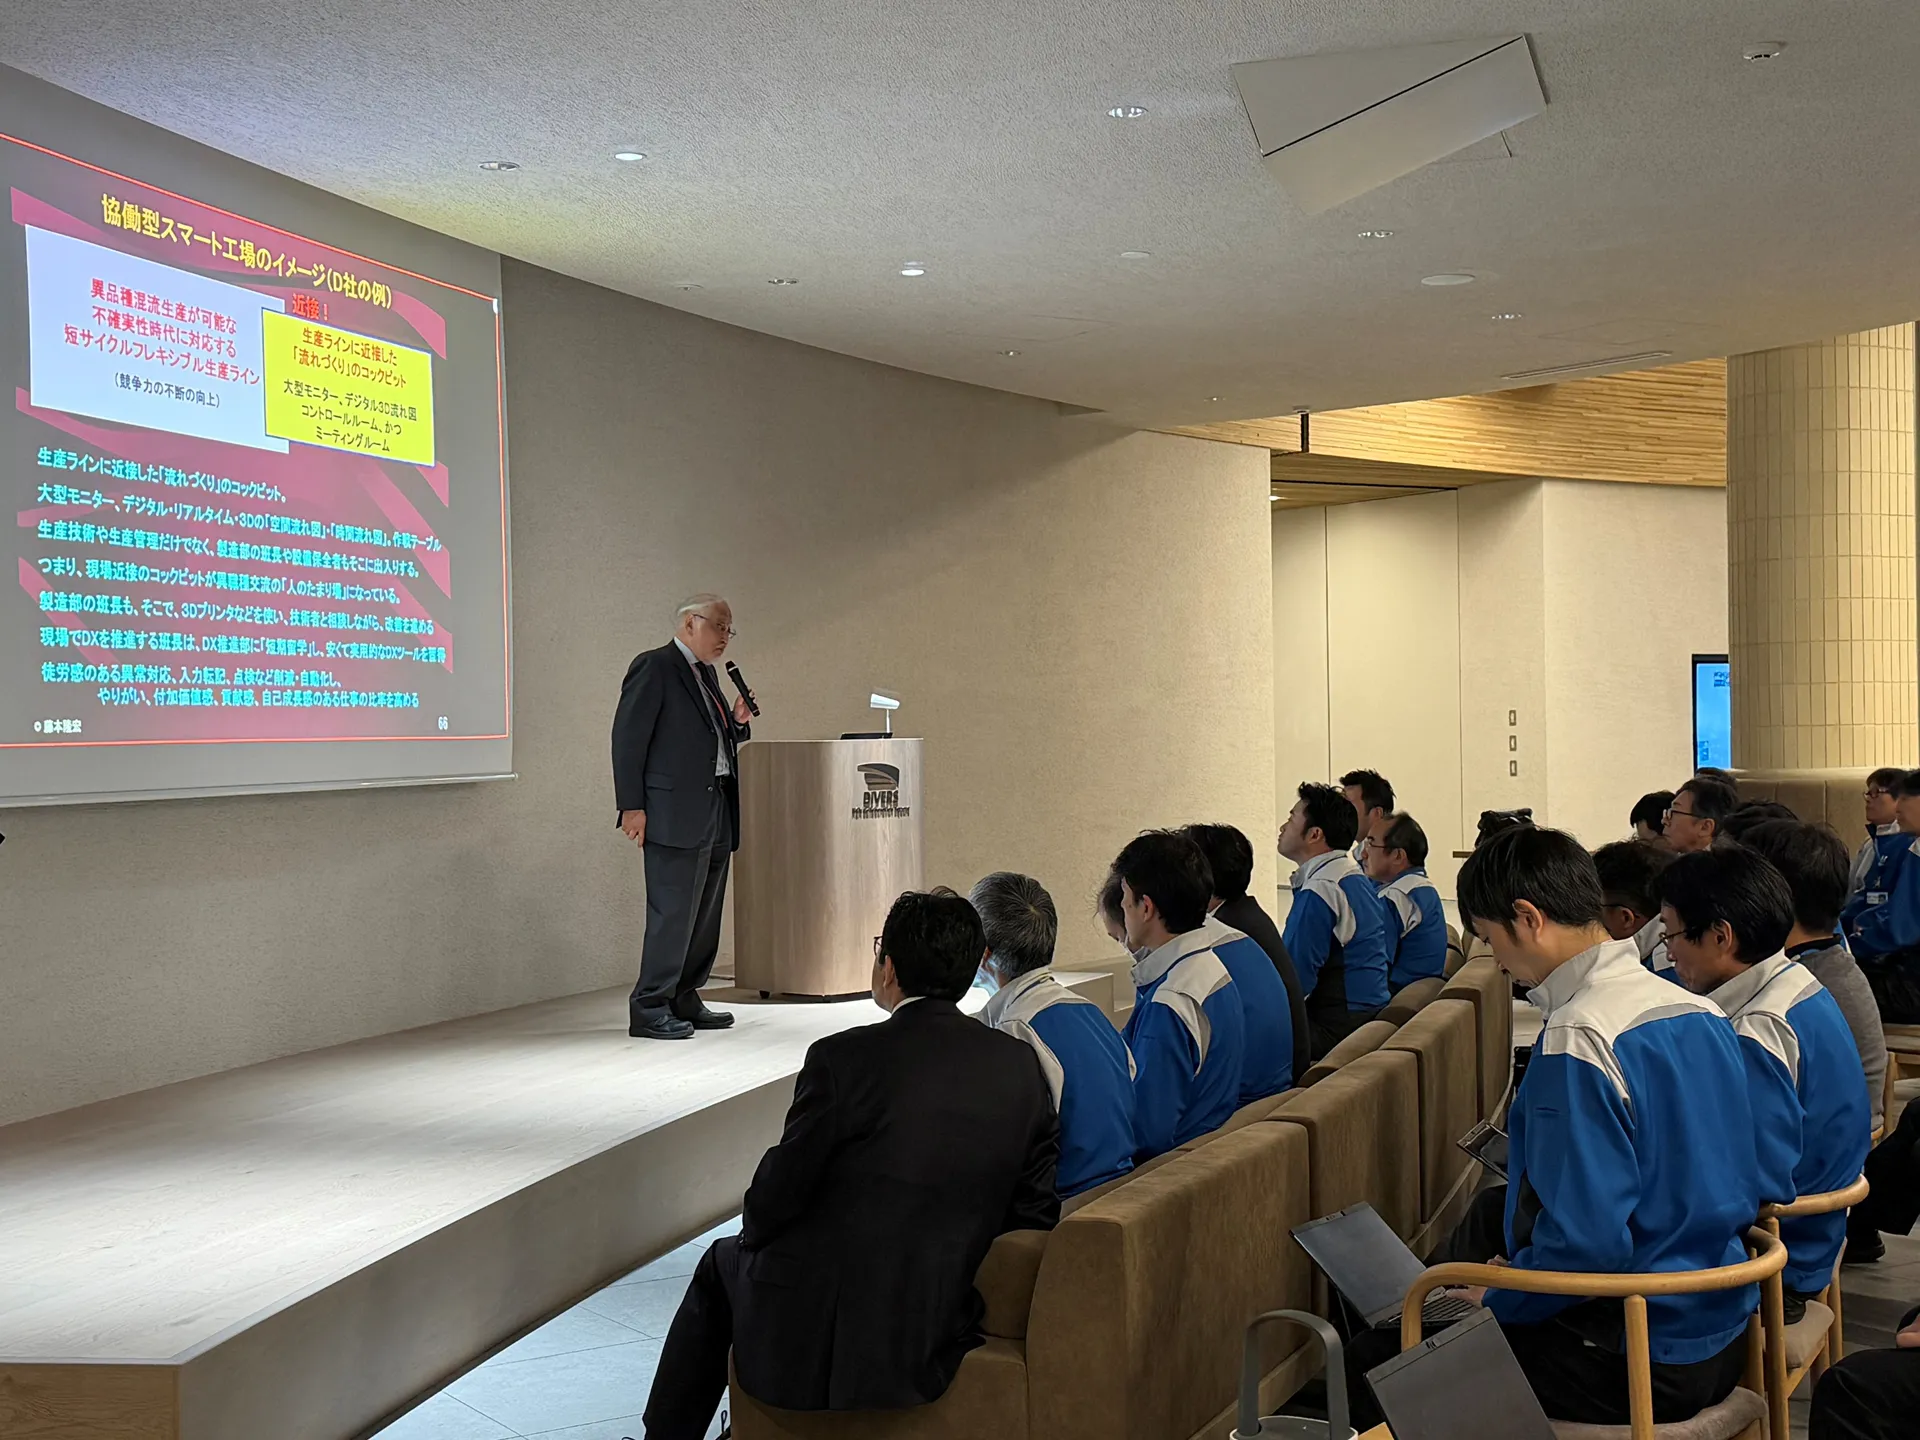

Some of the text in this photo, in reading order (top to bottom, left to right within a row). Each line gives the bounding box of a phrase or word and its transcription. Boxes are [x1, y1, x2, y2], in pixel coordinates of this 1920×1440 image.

[90, 278, 238, 335] 異品種混流生産が可能な
[292, 293, 329, 322] 近接！
[92, 305, 237, 358] 不確実性時代に対応する
[302, 327, 398, 367] 生産ラインに近接した
[64, 323, 261, 386] 短サイクルフレキシブル生産ライン
[114, 372, 221, 408] （競争力の不断の向上）
[283, 379, 417, 421] 大型モニター、デジタル3D流れ図
[301, 404, 402, 435] コントロールルーム、かつ
[315, 425, 391, 452] ミーティングルーム
[863, 790, 899, 808] DIVERS
